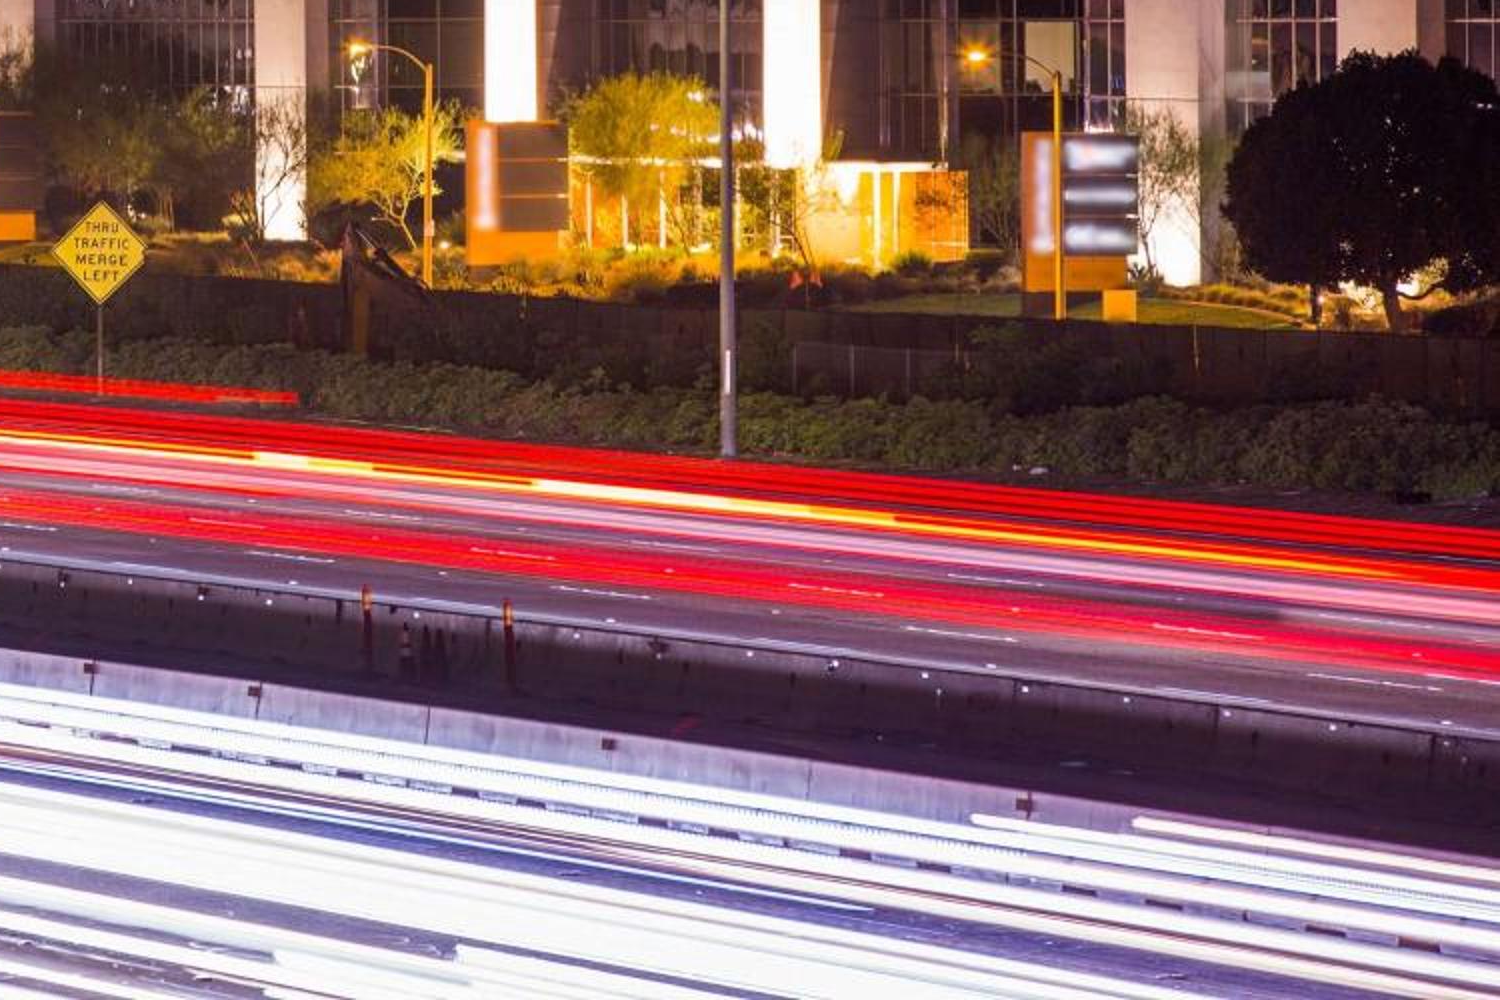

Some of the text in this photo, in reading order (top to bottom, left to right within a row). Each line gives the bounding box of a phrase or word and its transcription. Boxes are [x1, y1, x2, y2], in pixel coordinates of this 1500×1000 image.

[85, 222, 118, 233] THRU
[74, 238, 129, 250] TRAFFIC
[76, 254, 128, 266] MERGE
[84, 270, 119, 282] LEFT
